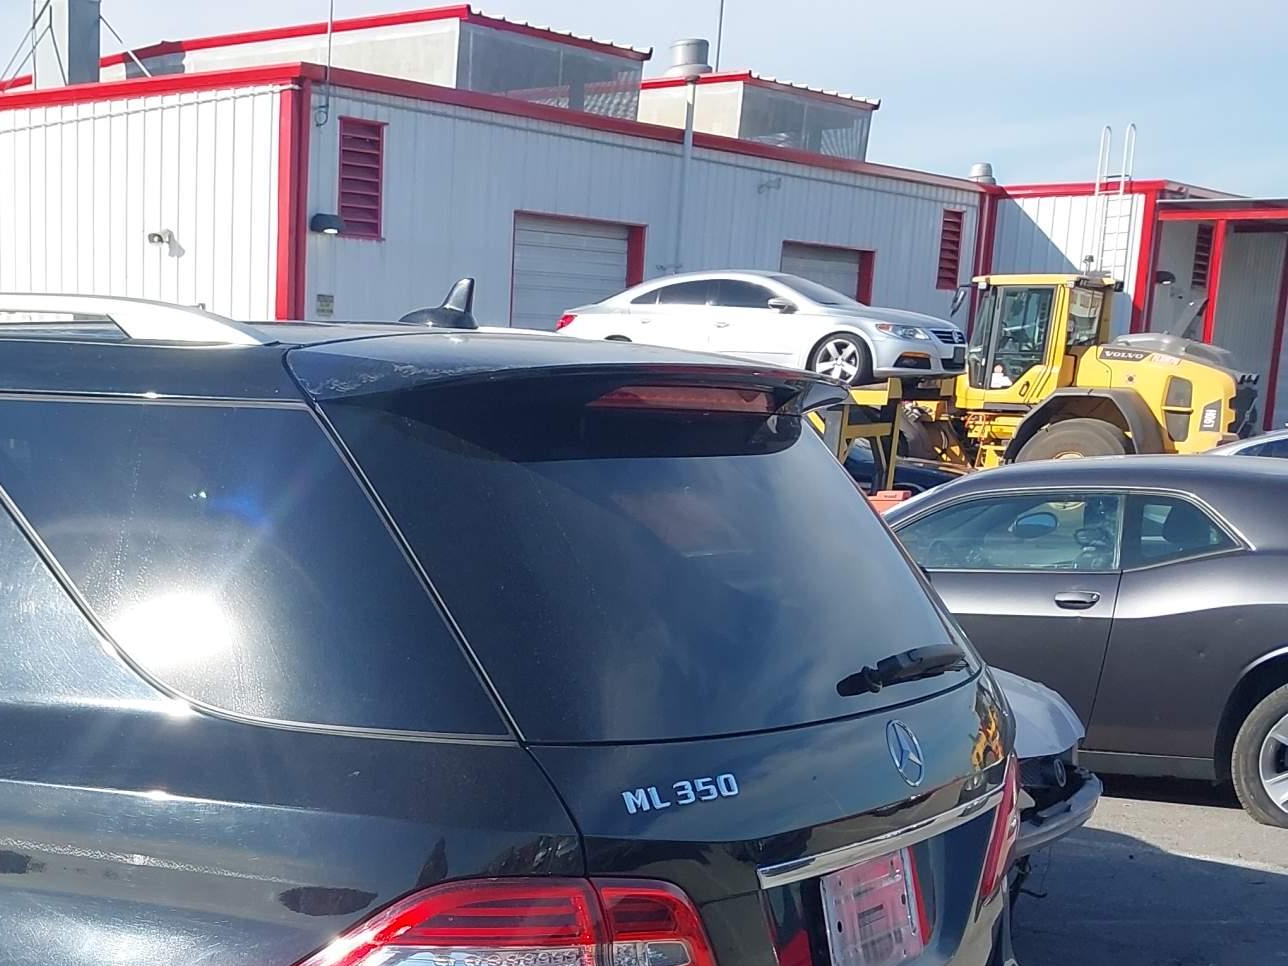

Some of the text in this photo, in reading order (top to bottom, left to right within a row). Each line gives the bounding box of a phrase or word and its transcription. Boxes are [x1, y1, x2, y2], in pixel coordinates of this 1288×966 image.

[1104, 350, 1144, 360] VOLVO
[622, 773, 739, 815] ML 350
